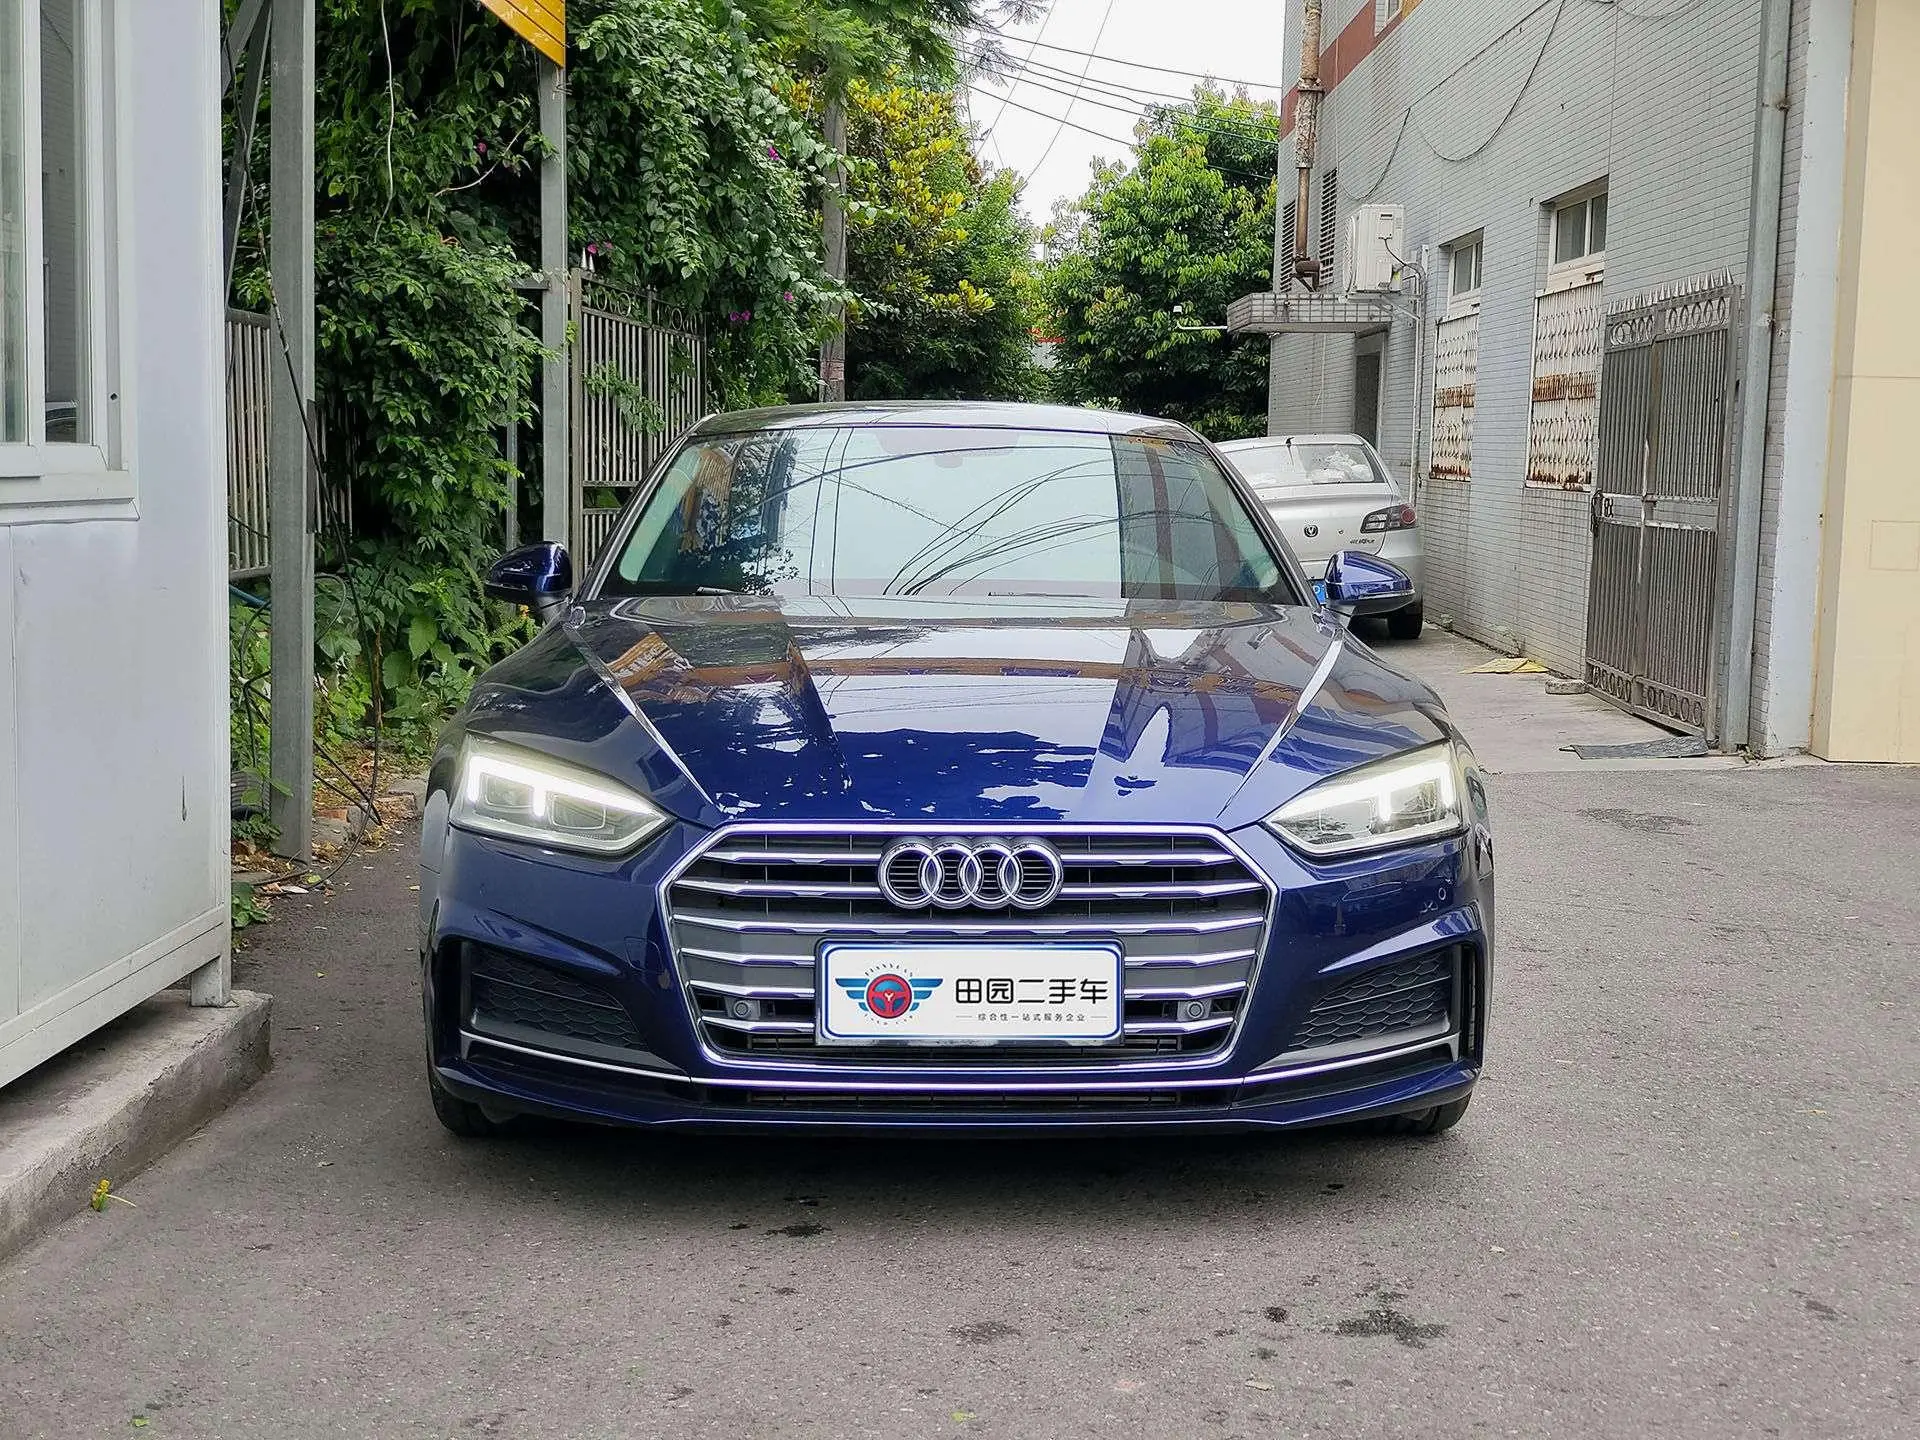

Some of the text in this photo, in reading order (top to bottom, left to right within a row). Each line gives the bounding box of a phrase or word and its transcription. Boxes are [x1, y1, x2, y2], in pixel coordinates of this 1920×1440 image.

[955, 977, 1109, 1005] 田园二手车
